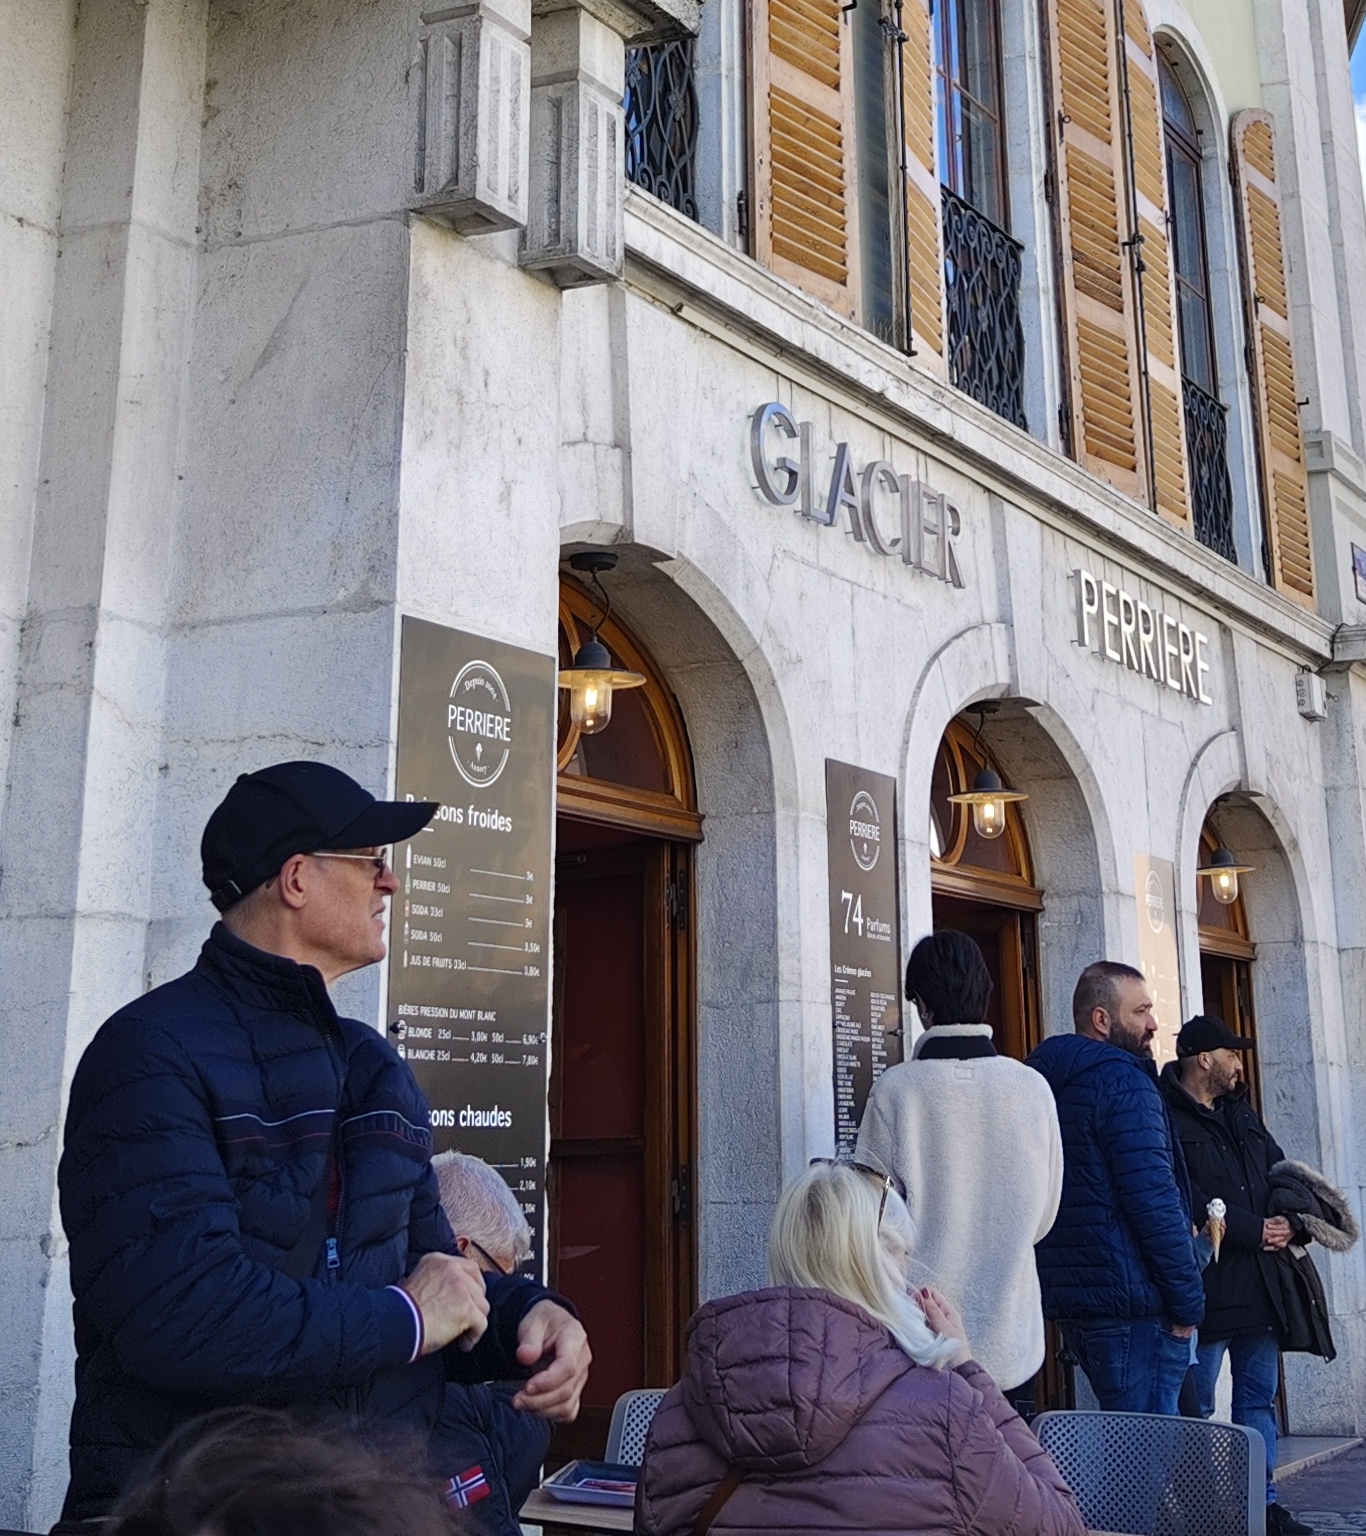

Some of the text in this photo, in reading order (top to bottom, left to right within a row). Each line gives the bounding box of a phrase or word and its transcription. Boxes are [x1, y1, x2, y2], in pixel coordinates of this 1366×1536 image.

[748, 402, 966, 589] GLACIER
[1070, 568, 1213, 706] PERRIERE
[448, 704, 511, 741] PERRIERE
[468, 805, 512, 832] froides
[849, 819, 880, 842] PERRIERE
[413, 854, 432, 866] EVIAN
[433, 857, 446, 868] 50cl
[412, 879, 436, 891] PERRIER
[437, 883, 450, 894] 50cl
[411, 904, 428, 916] SODA
[841, 889, 891, 936] 74 Parfums
[410, 929, 427, 941] SODA
[408, 1026, 433, 1039] BLONDE
[407, 1048, 436, 1061] BLANCHE
[459, 1104, 512, 1127] chaudes
